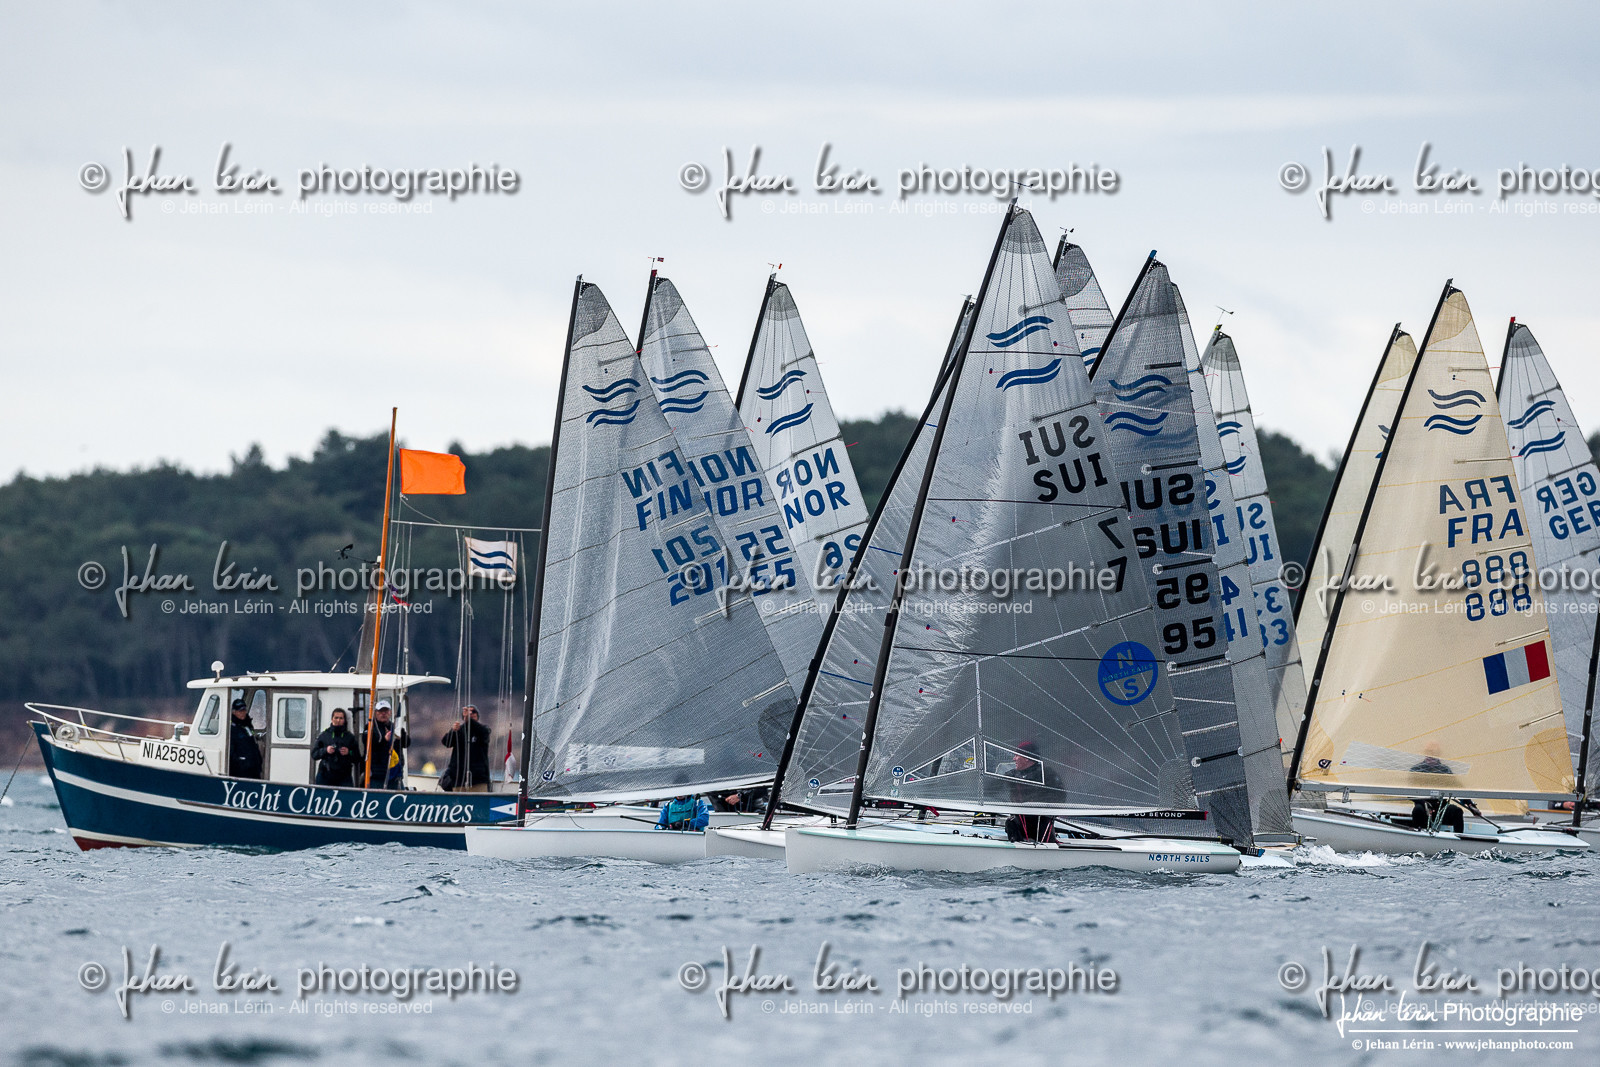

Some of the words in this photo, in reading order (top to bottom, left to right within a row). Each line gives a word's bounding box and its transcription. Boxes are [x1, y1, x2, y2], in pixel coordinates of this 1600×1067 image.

[1033, 452, 1108, 502] SUI
[636, 479, 693, 531] FIN
[784, 481, 850, 529] NOR
[1133, 519, 1203, 559] SUI
[1448, 508, 1524, 548] FRA
[667, 556, 729, 606] 201
[1107, 556, 1127, 593] 7
[1465, 583, 1532, 622] 888
[1162, 616, 1216, 655] 95
[1123, 678, 1139, 697] S
[221, 780, 282, 812] Yacht
[288, 786, 343, 817] Club
[350, 792, 379, 820] de
[385, 793, 474, 824] Cannes
[1148, 853, 1181, 863] NORTH
[1184, 854, 1210, 863] SAILS
